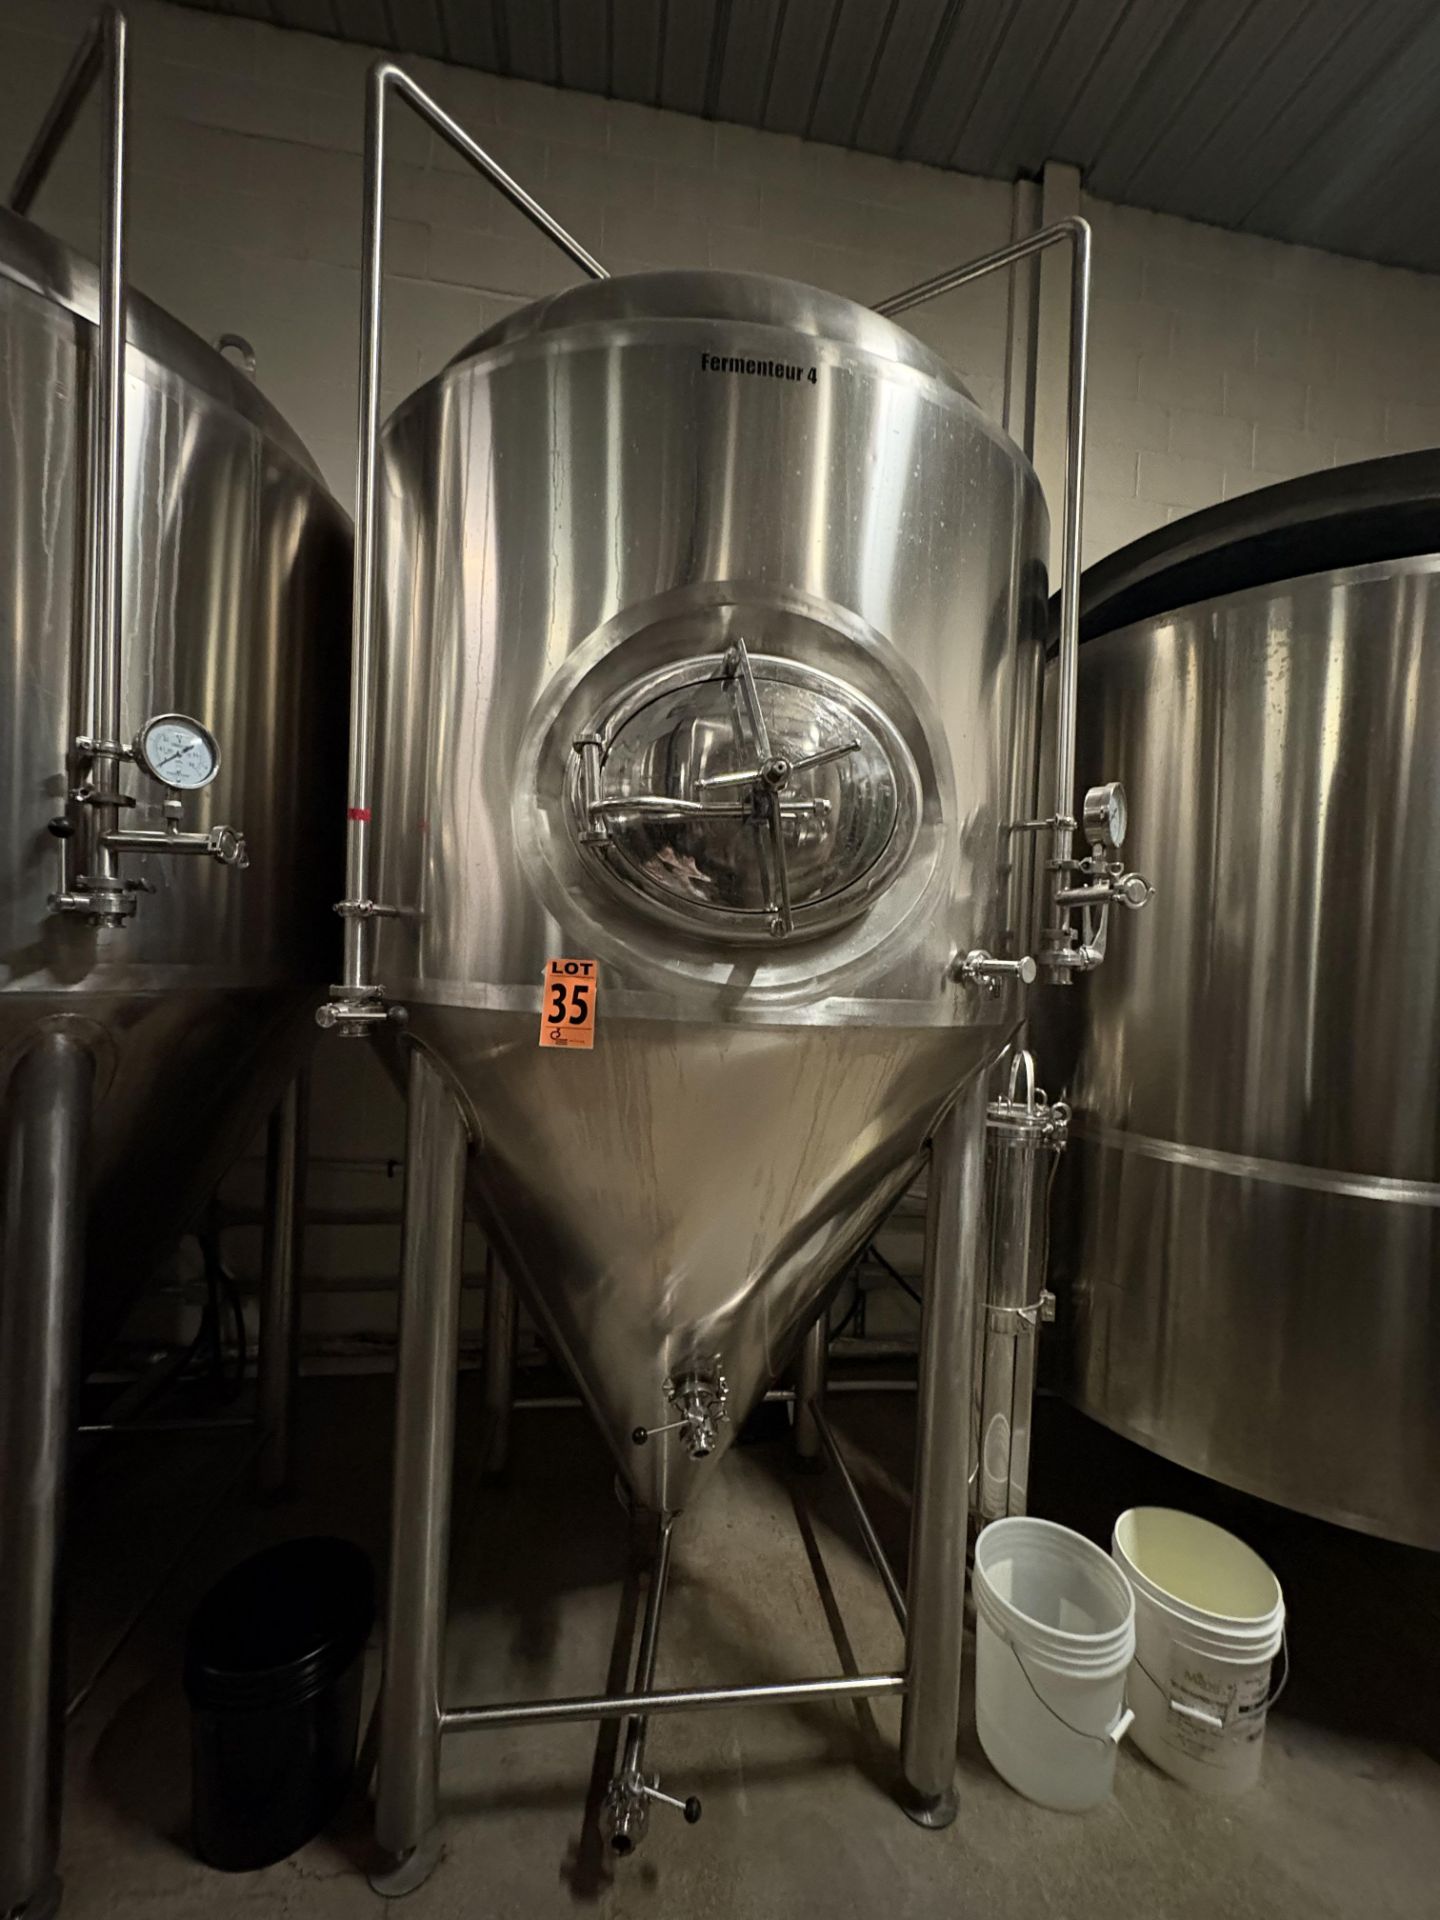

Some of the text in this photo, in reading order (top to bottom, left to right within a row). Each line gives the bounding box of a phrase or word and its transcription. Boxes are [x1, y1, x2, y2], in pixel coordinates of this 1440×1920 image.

[701, 353, 818, 384] Fermenteur 4
[551, 961, 593, 975] LOT
[548, 983, 589, 1025] 35
